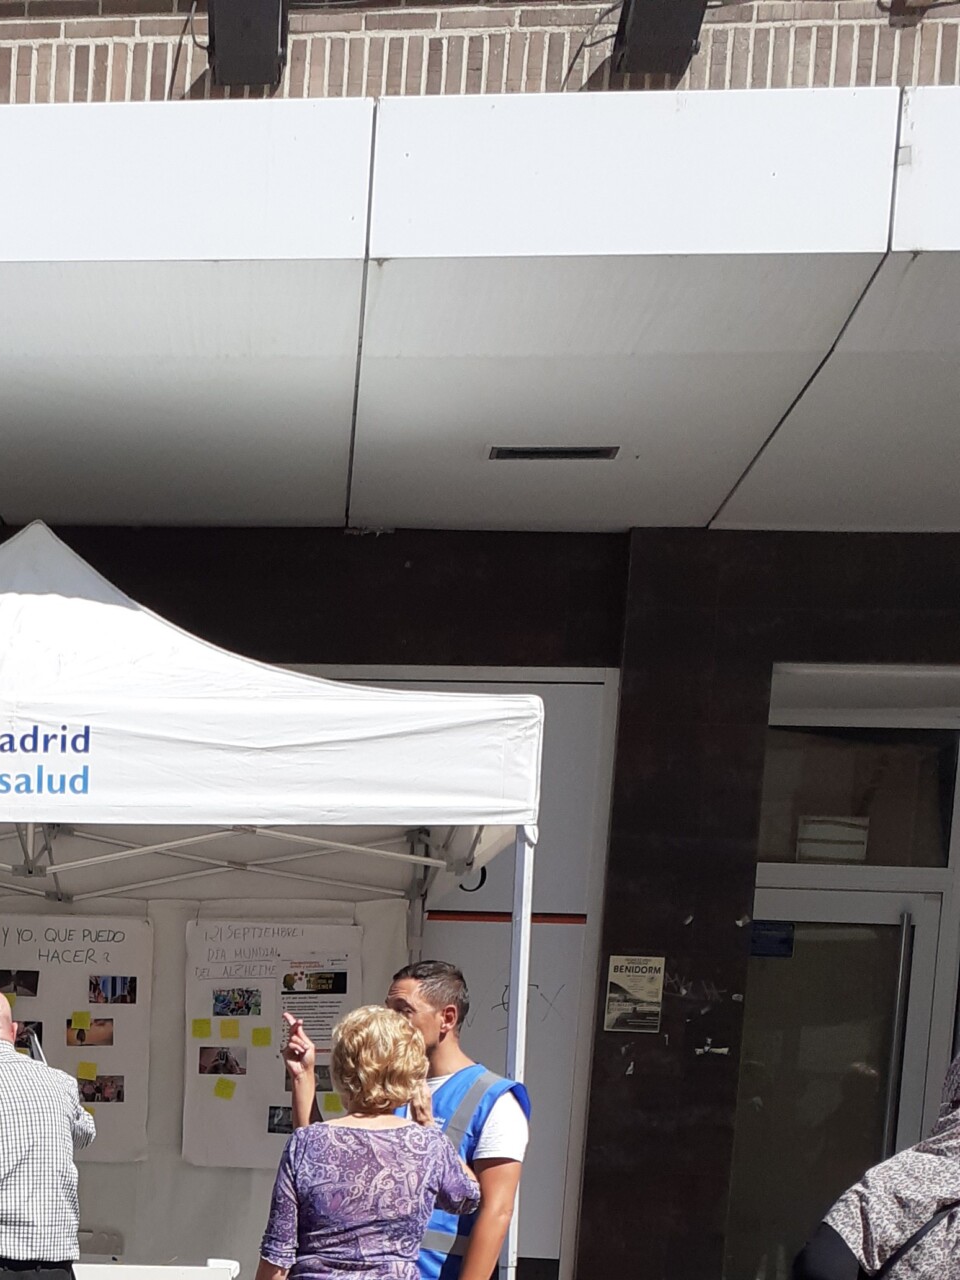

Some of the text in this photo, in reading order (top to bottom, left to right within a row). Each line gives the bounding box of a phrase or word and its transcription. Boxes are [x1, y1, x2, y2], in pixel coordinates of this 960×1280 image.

[44, 927, 76, 943] QUE
[82, 928, 125, 943] PUEDO
[613, 965, 662, 975] BENIDORM
